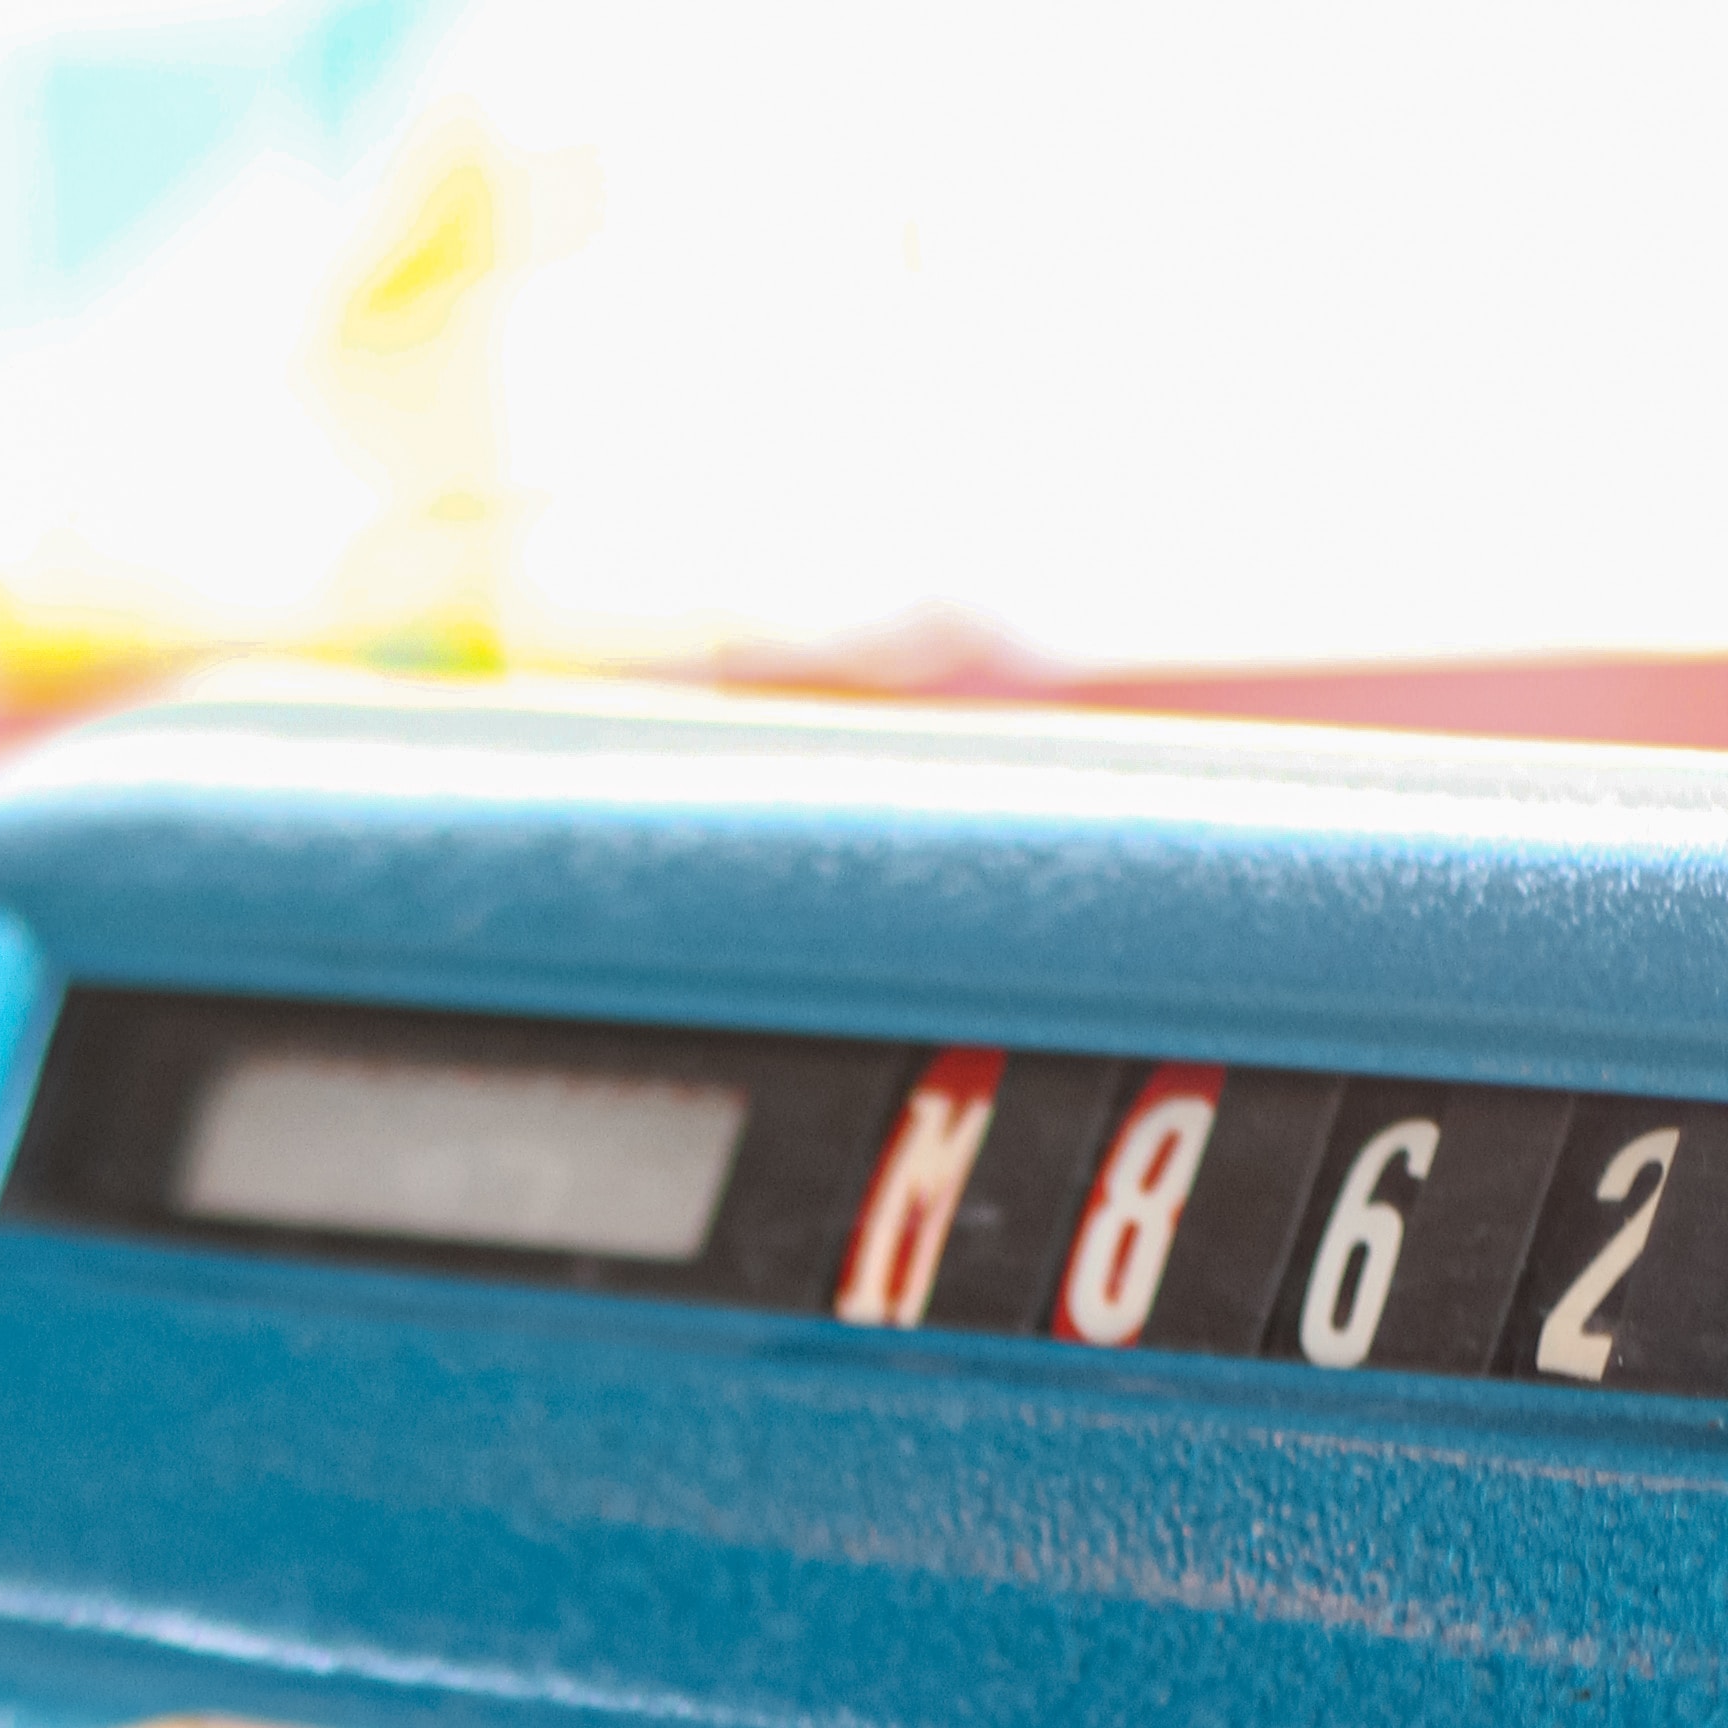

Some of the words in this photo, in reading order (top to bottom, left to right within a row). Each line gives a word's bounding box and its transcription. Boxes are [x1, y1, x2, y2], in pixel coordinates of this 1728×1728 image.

[1066, 1098, 1217, 1346] 8
[1299, 1116, 1441, 1368] 6
[1536, 1126, 1680, 1380] 2
